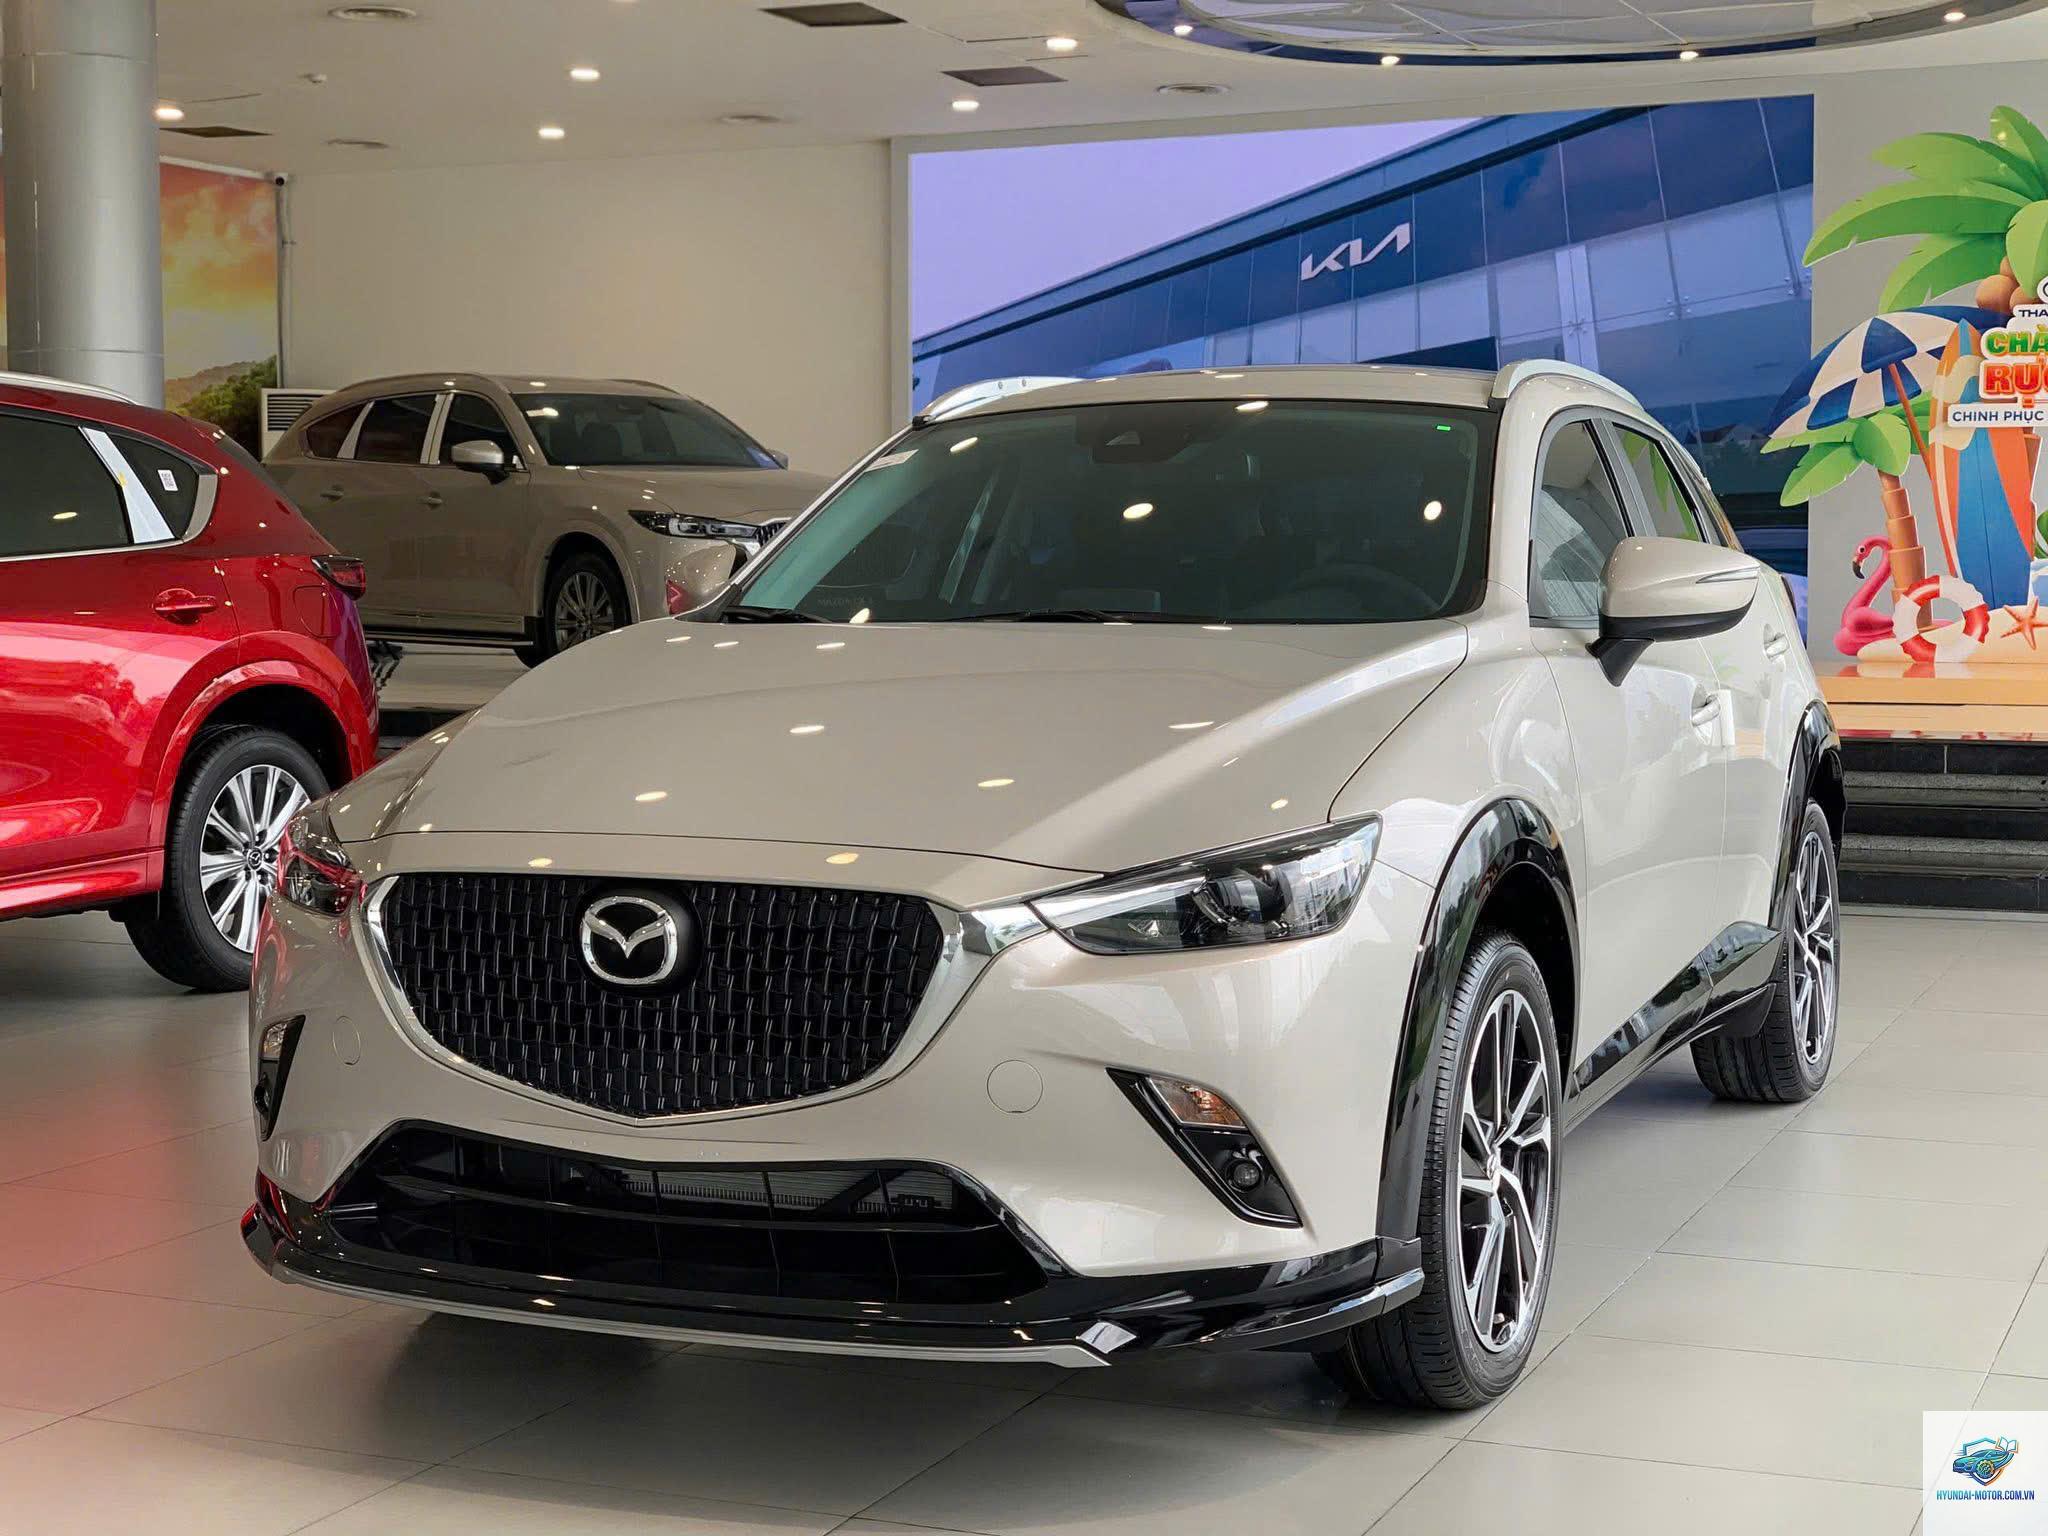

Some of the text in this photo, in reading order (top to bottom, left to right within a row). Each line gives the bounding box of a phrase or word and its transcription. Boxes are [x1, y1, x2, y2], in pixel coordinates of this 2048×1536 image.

[1301, 222, 1411, 281] KIA
[1984, 356, 2048, 408] RỰ
[1952, 411, 2045, 424] CHINH PHỤC
